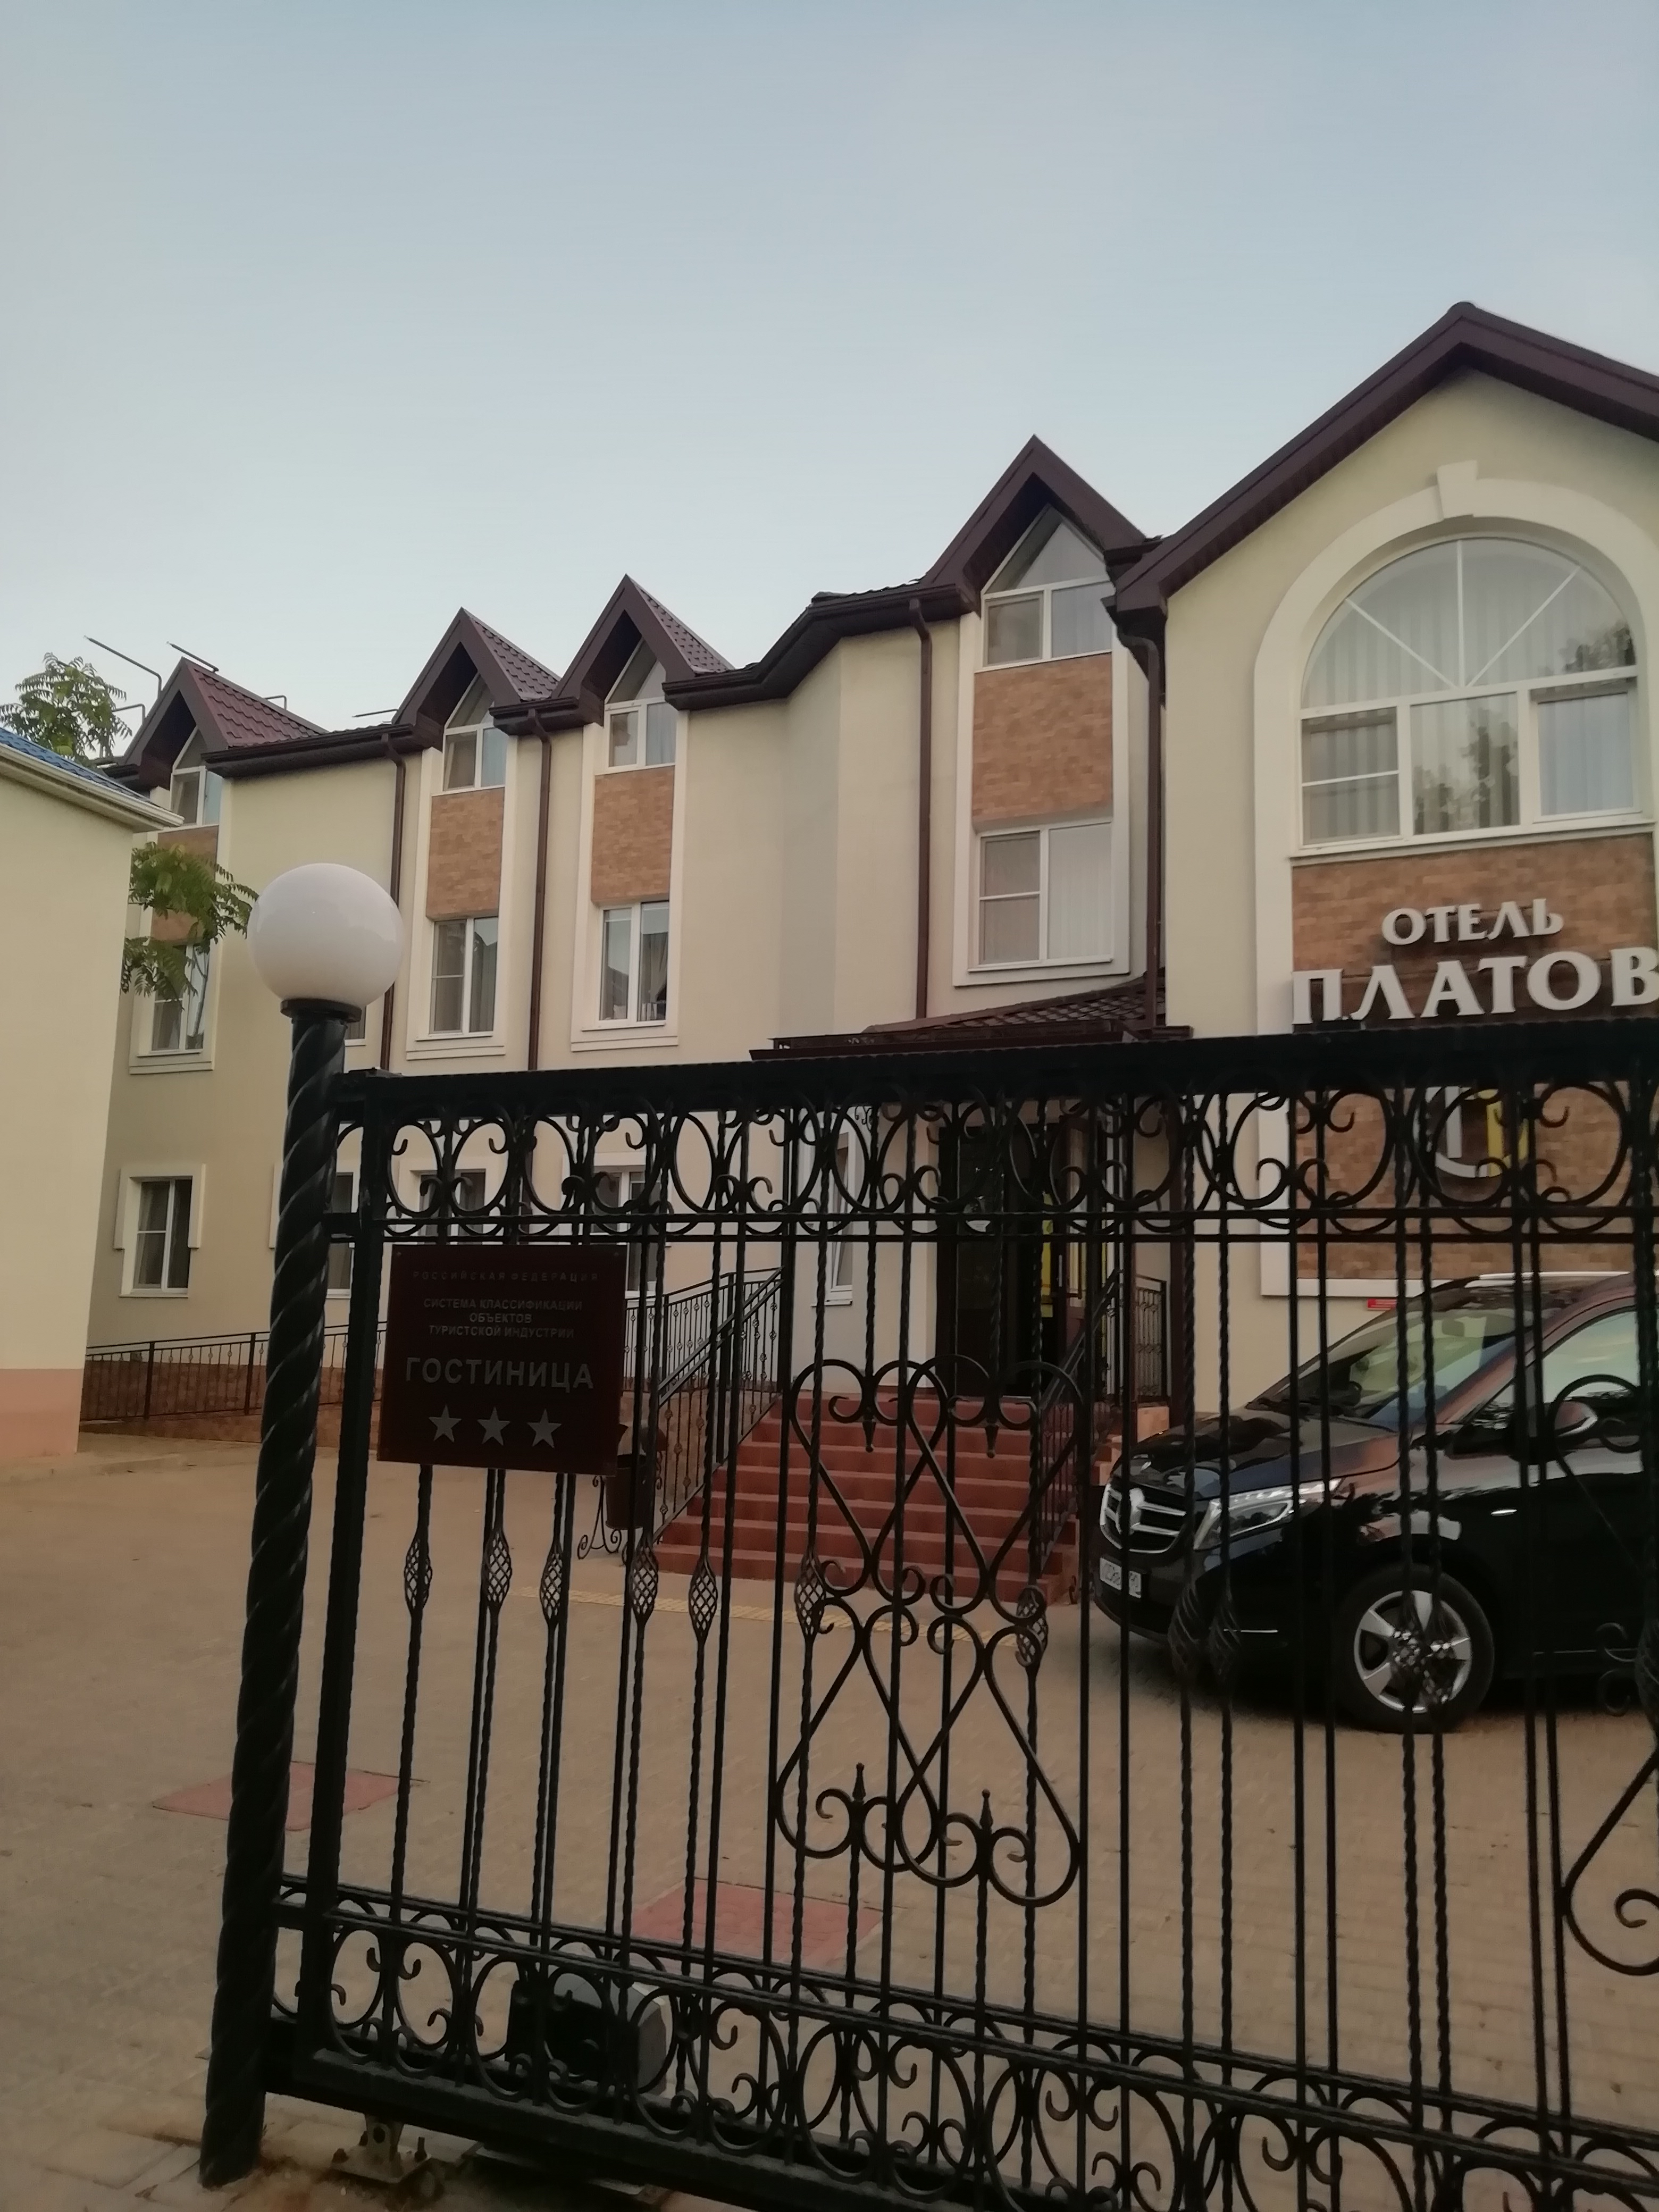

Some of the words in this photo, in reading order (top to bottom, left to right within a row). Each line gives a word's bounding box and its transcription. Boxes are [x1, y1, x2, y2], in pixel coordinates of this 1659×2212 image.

[1382, 898, 1564, 945] ОТЕЛЬ
[1292, 946, 1659, 1025] ПЛАТОВ
[413, 1270, 506, 1281] РОССИЙСКАЯ
[510, 1271, 598, 1283] ФЕДЕРАЦИЯ
[423, 1298, 477, 1309] СИСТЕМА
[480, 1298, 583, 1311] КЛАССИФИКАЦИИ
[470, 1313, 532, 1323] ОБЪЕКТОВ
[429, 1325, 501, 1337] ТУРИСТСКОЙ
[504, 1326, 575, 1339] ИНДУСТРИИ
[406, 1356, 594, 1393] ГОСТИНИЦА
